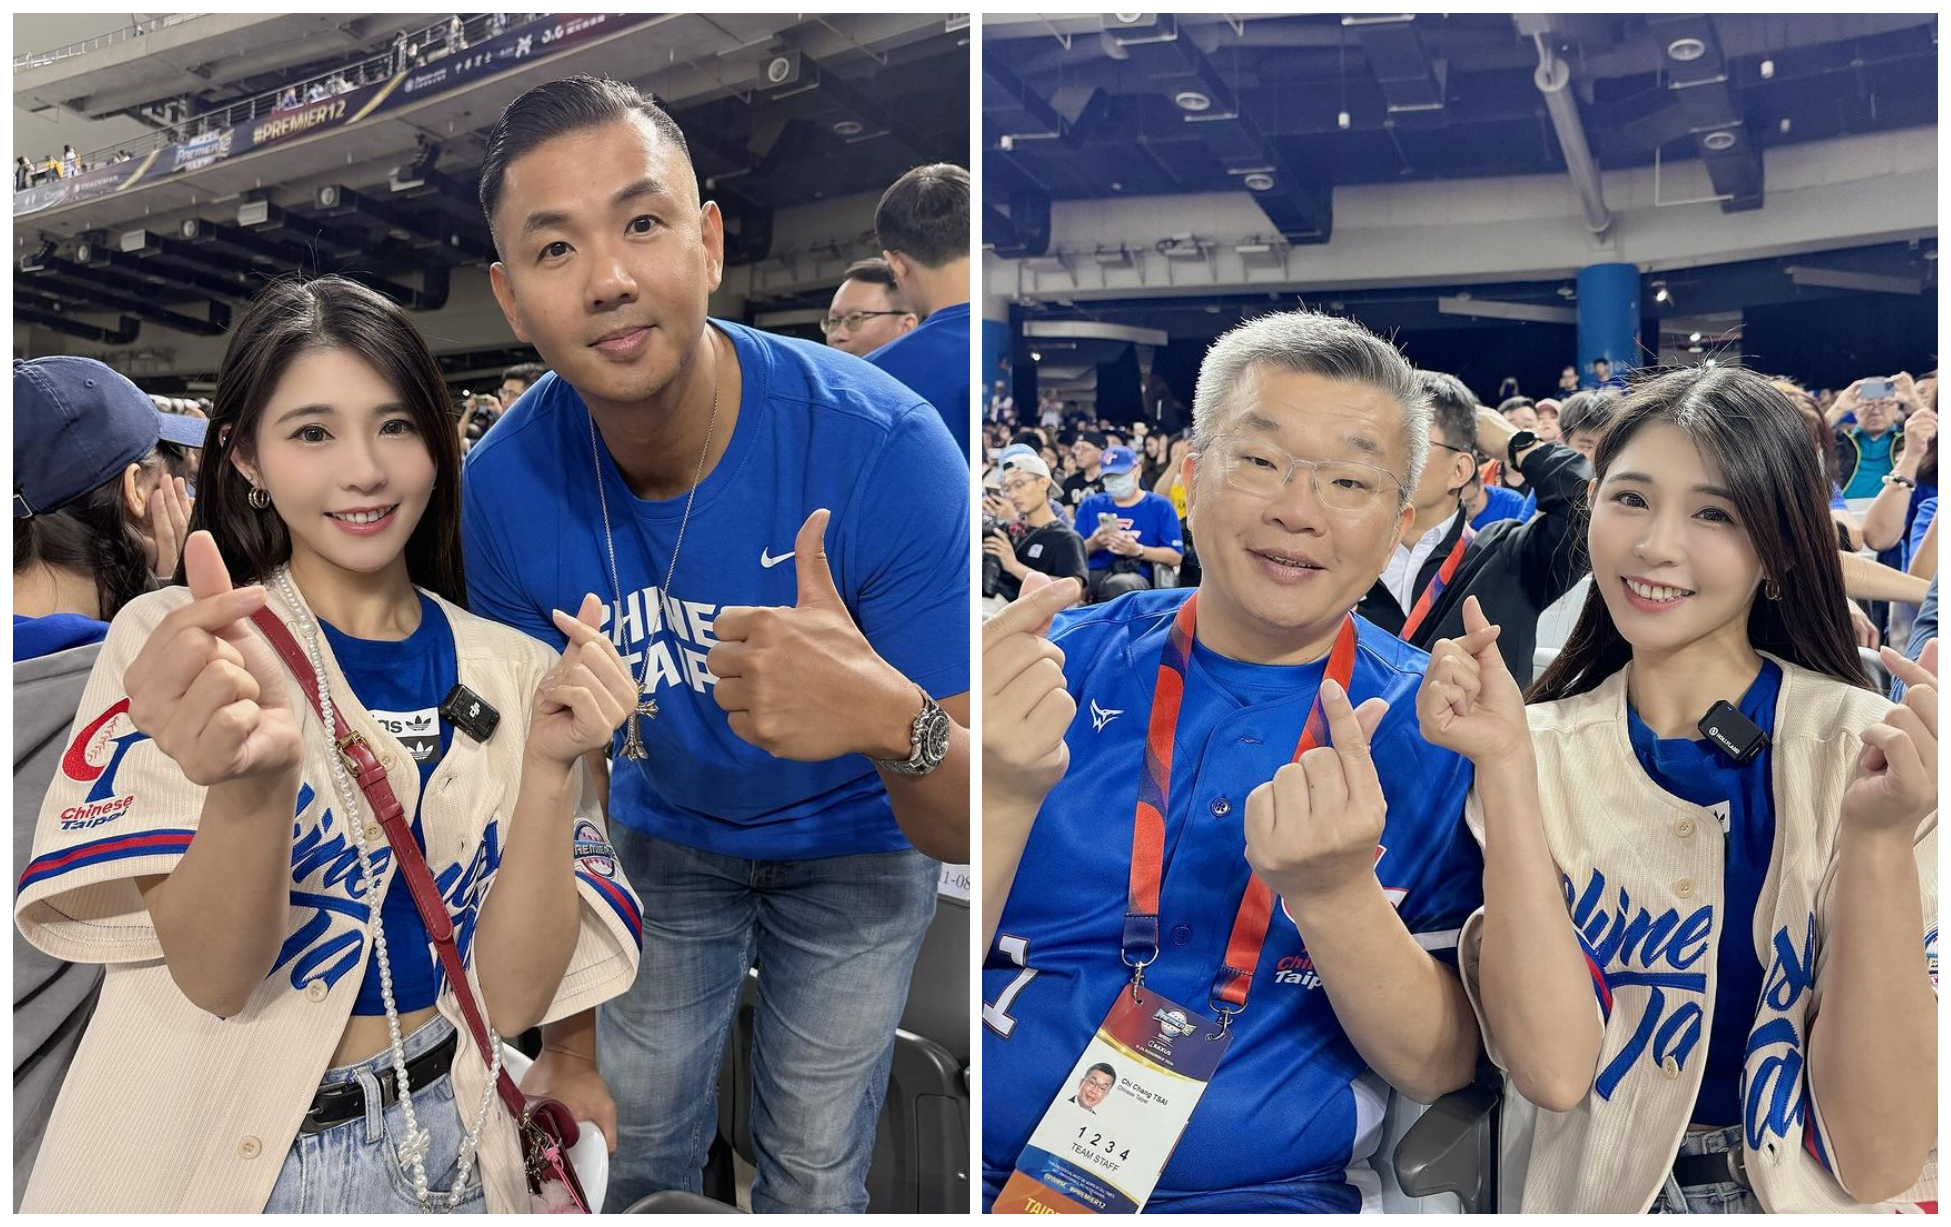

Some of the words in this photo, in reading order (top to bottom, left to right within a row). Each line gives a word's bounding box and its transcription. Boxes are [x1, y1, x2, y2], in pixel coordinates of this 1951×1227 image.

[253, 101, 346, 144] #PREMIER12
[1716, 733, 1741, 755] HOLLYLAND
[61, 795, 134, 820] Chinese
[61, 805, 129, 831] Taipei
[1275, 969, 1322, 990] Taip
[1121, 1077, 1133, 1088] Chi
[1132, 1083, 1152, 1099] Chang
[1153, 1093, 1168, 1106] TSAI
[1078, 1126, 1087, 1138] 1
[1090, 1133, 1102, 1146] 2
[1105, 1140, 1116, 1154] 3
[1119, 1149, 1130, 1161] 4
[1071, 1142, 1094, 1161] TEAM
[1093, 1154, 1120, 1173] STAFF
